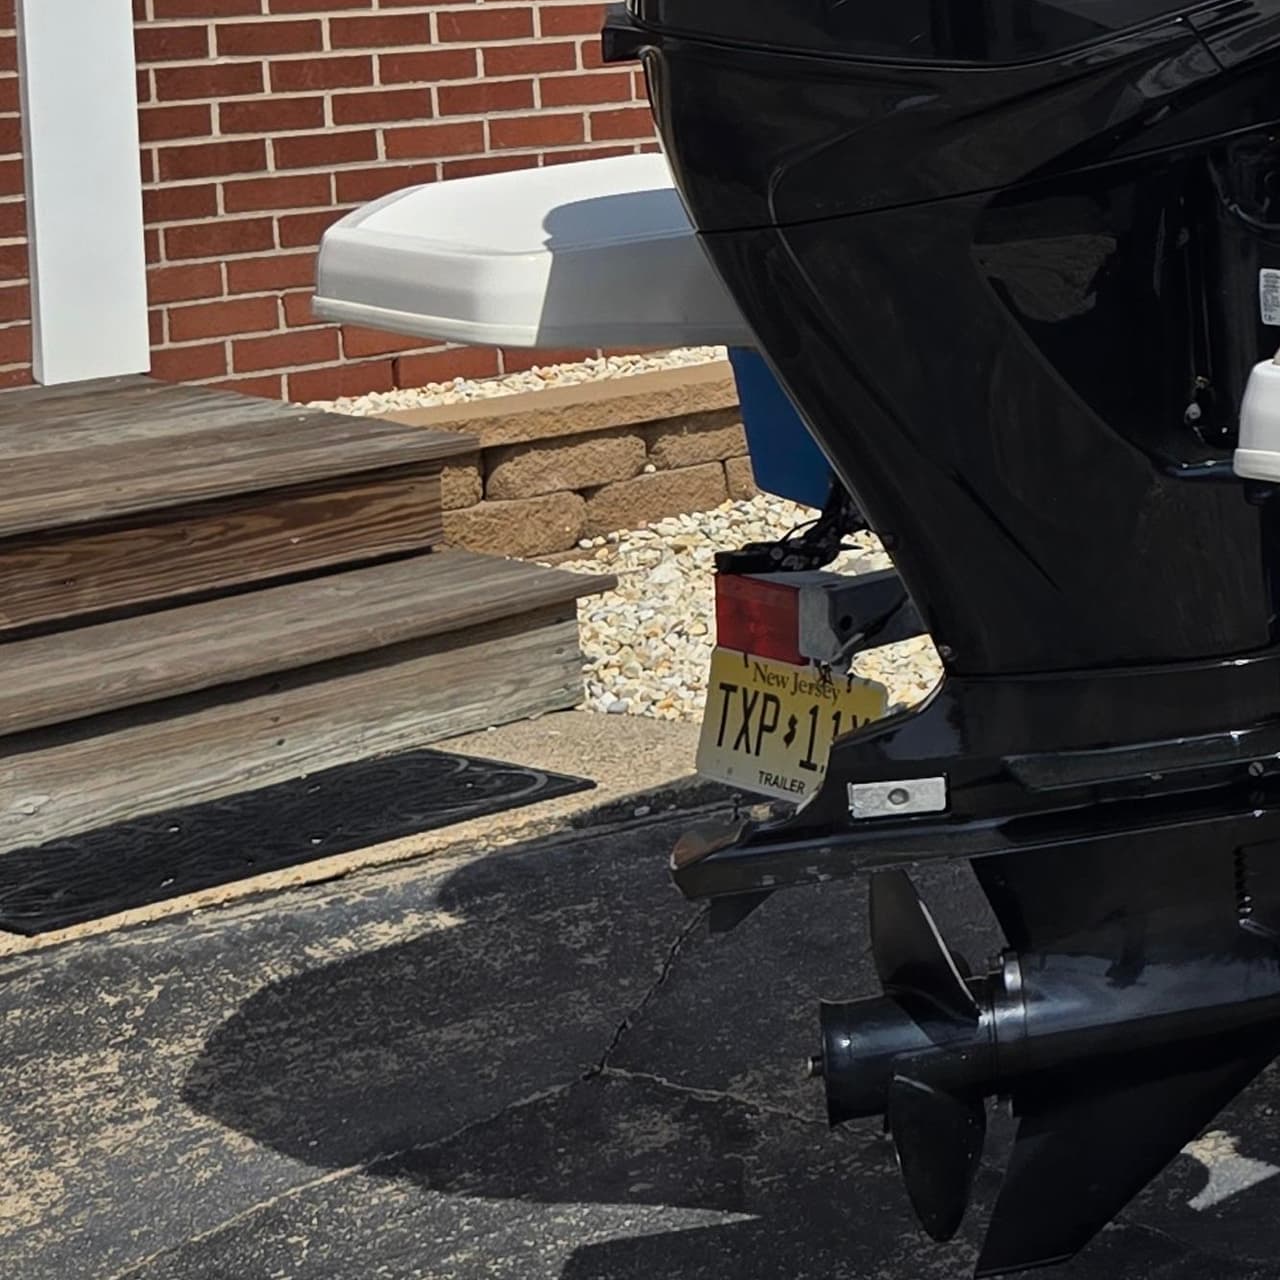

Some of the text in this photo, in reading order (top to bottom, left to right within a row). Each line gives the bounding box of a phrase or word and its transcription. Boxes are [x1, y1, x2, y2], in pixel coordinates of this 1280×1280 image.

[753, 661, 841, 704] New Jersey
[716, 681, 870, 773] TXP 11
[758, 770, 806, 795] TRAILER
